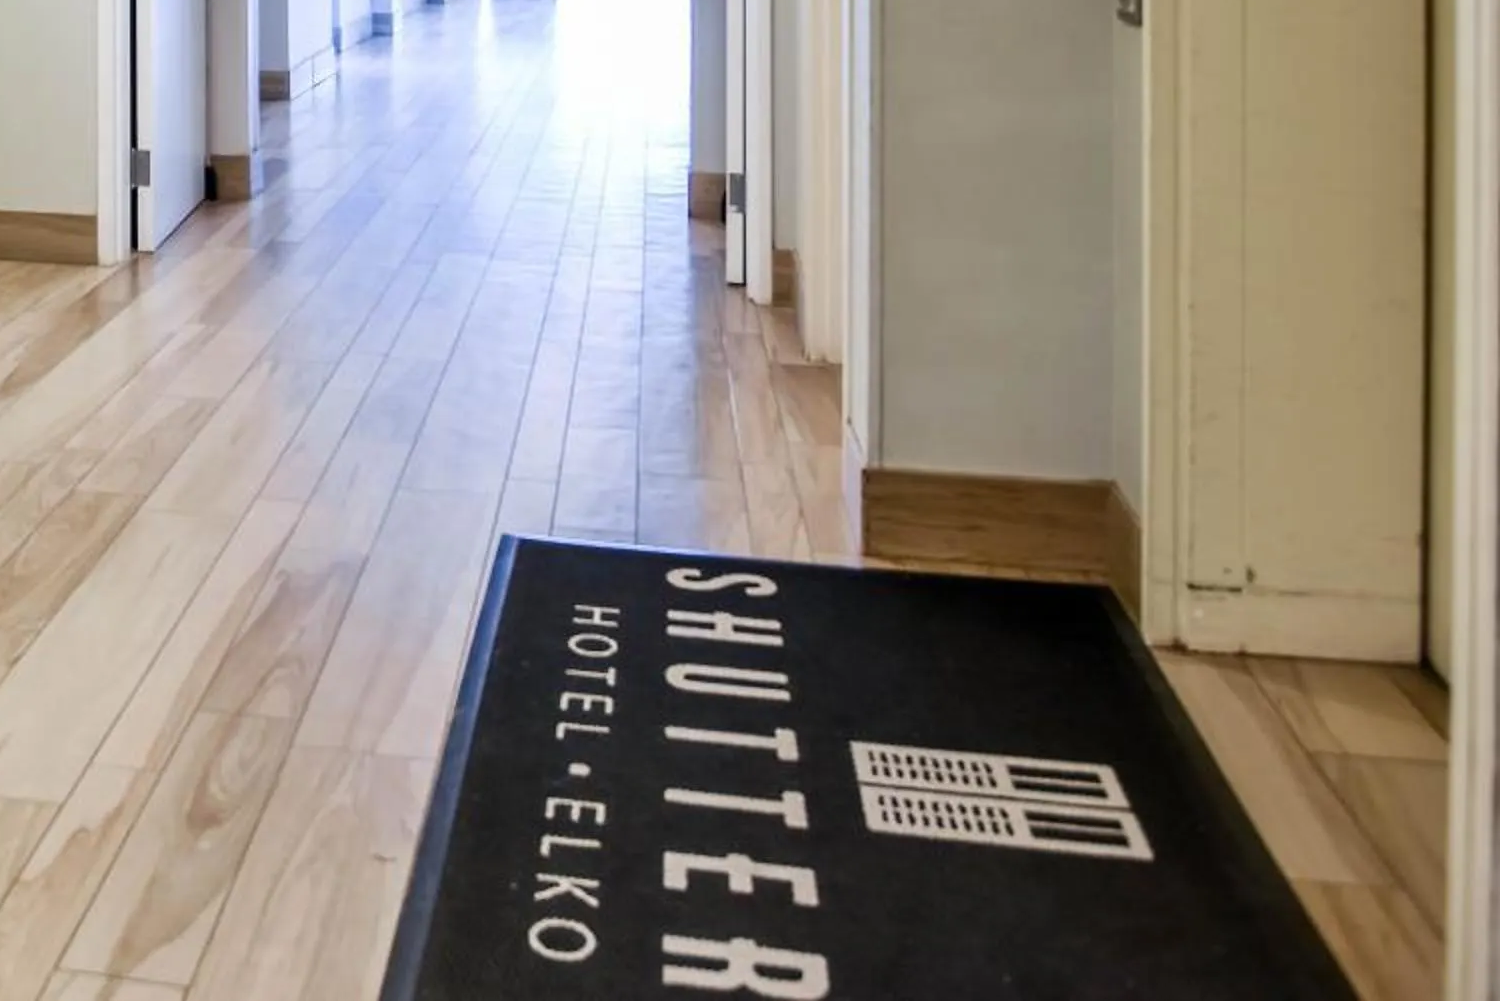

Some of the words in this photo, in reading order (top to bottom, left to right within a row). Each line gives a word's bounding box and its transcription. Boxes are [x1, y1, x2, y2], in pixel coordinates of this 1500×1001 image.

[555, 604, 621, 740] HOTEL
[662, 568, 830, 1000] SHUTTER
[528, 796, 606, 962] ELKO
